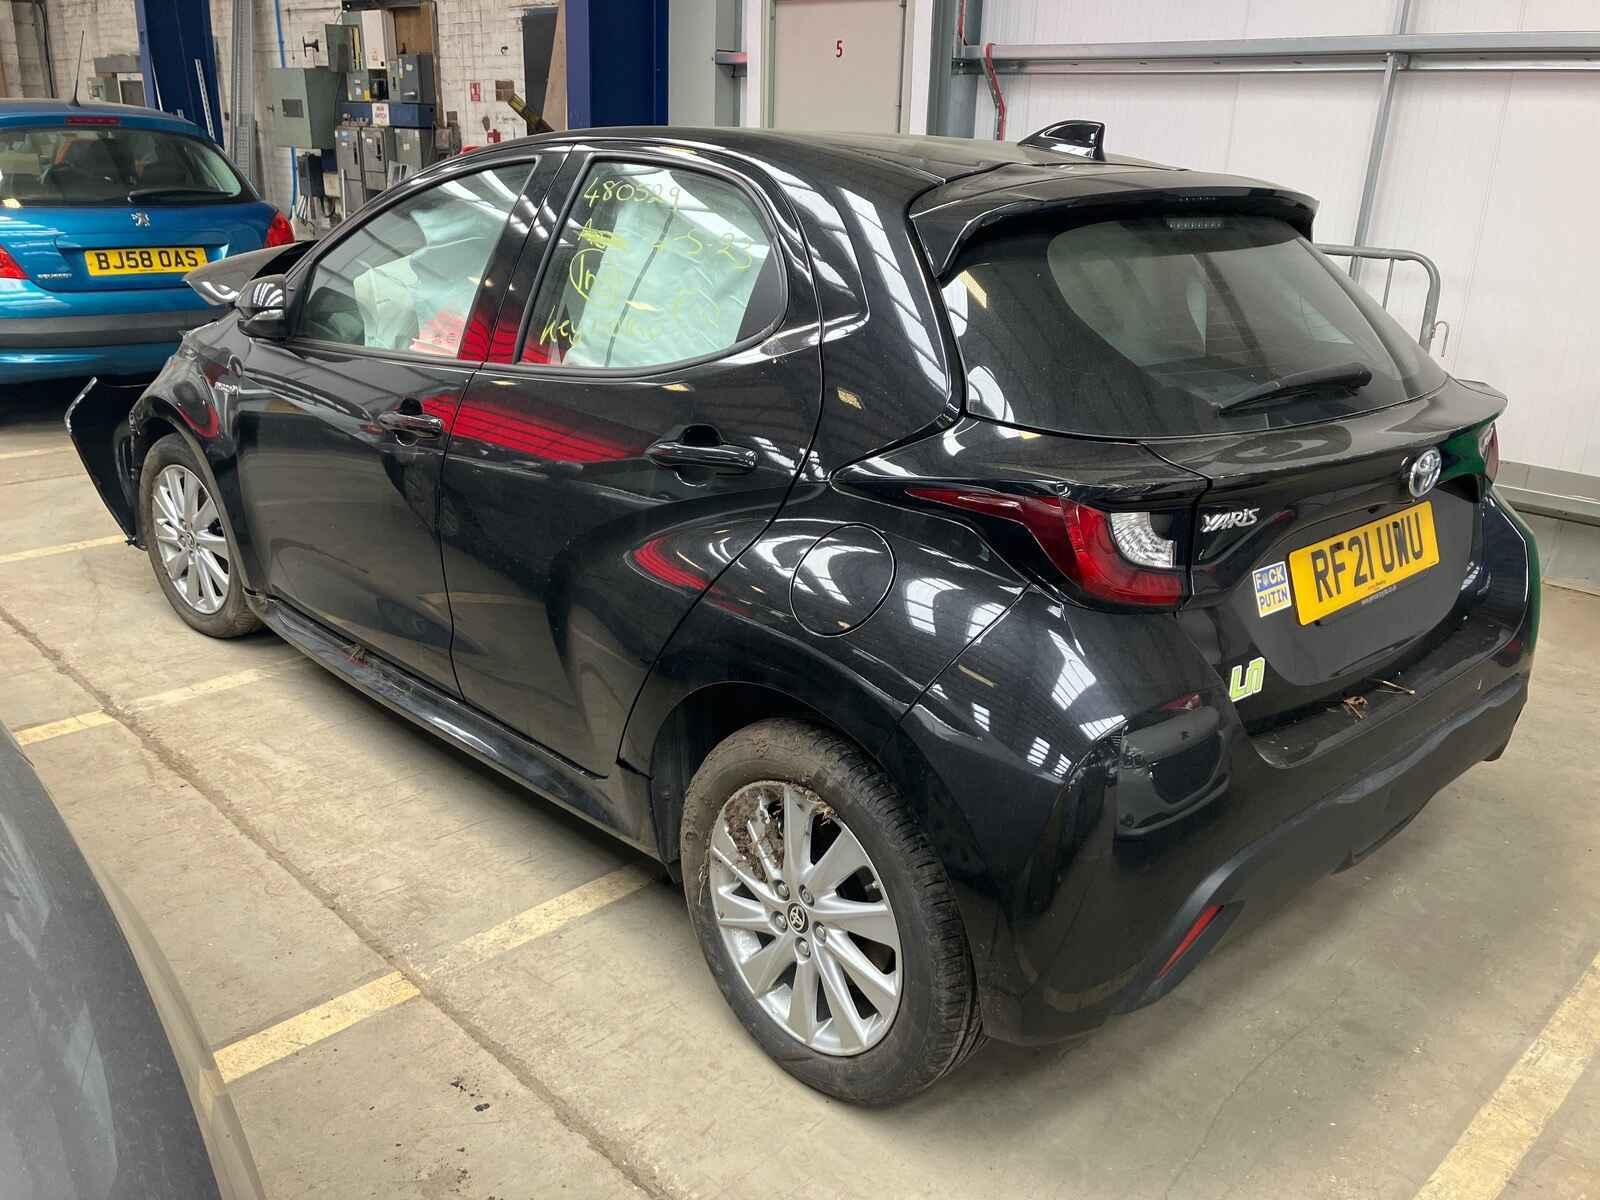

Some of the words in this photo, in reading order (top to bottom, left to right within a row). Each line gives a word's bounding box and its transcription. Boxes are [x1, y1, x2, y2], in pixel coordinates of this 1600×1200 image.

[835, 39, 844, 58] 5
[94, 250, 154, 271] BJ58
[157, 249, 199, 268] OAS
[1200, 508, 1260, 533] YARIS
[1310, 530, 1376, 603] RF21
[1376, 511, 1424, 574] UWU
[1259, 587, 1288, 610] PUTIN
